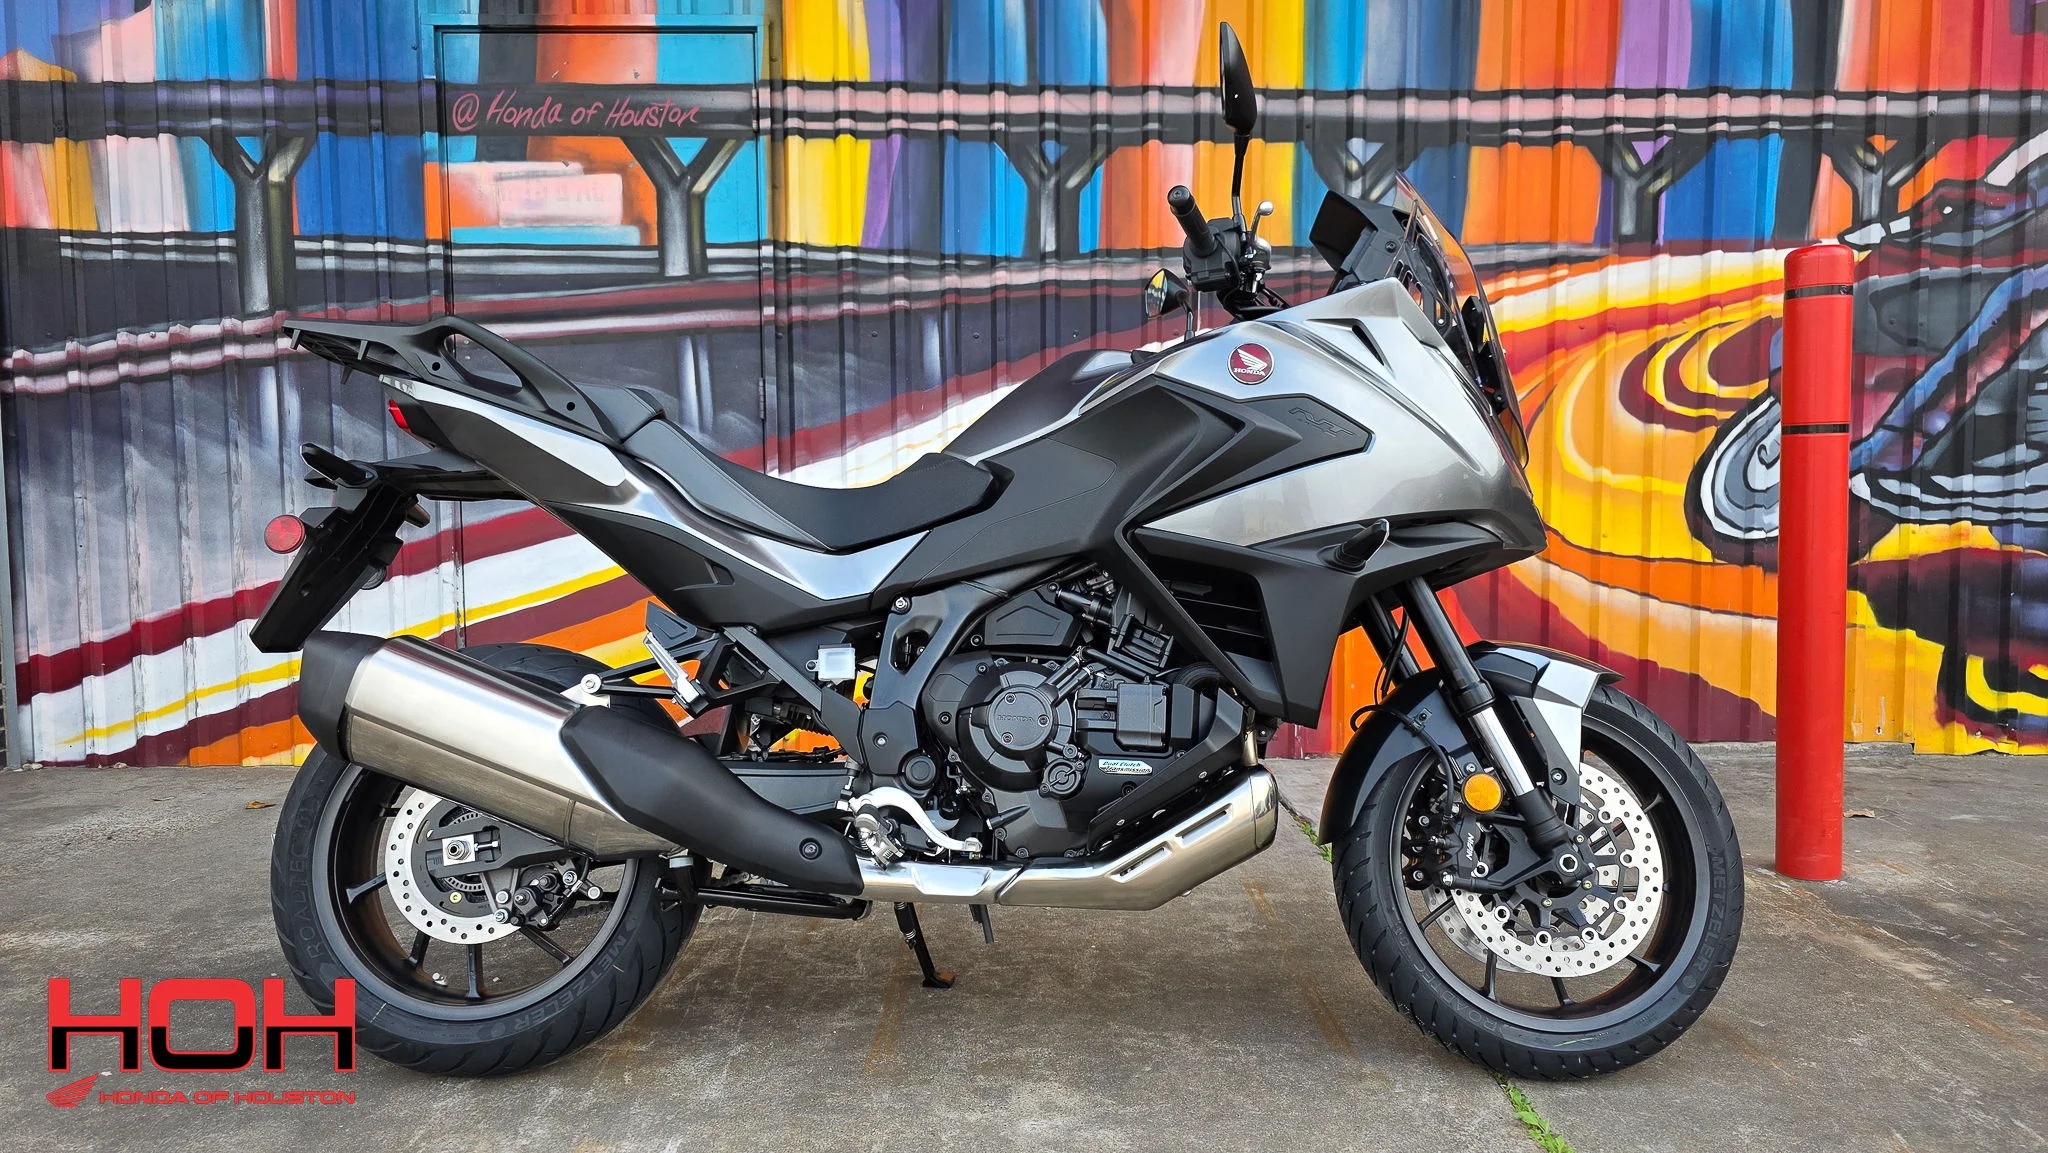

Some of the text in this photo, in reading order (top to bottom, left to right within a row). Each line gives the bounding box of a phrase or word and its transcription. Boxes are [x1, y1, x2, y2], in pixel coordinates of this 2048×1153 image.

[486, 88, 563, 130] Honda
[570, 101, 604, 125] of
[604, 96, 700, 128] Houston
[1233, 367, 1266, 378] HONDA
[997, 714, 1035, 724] HONDA
[1692, 855, 1727, 972] METZELER
[515, 935, 627, 1030] METZELER
[1413, 962, 1498, 1032] ROADTEC
